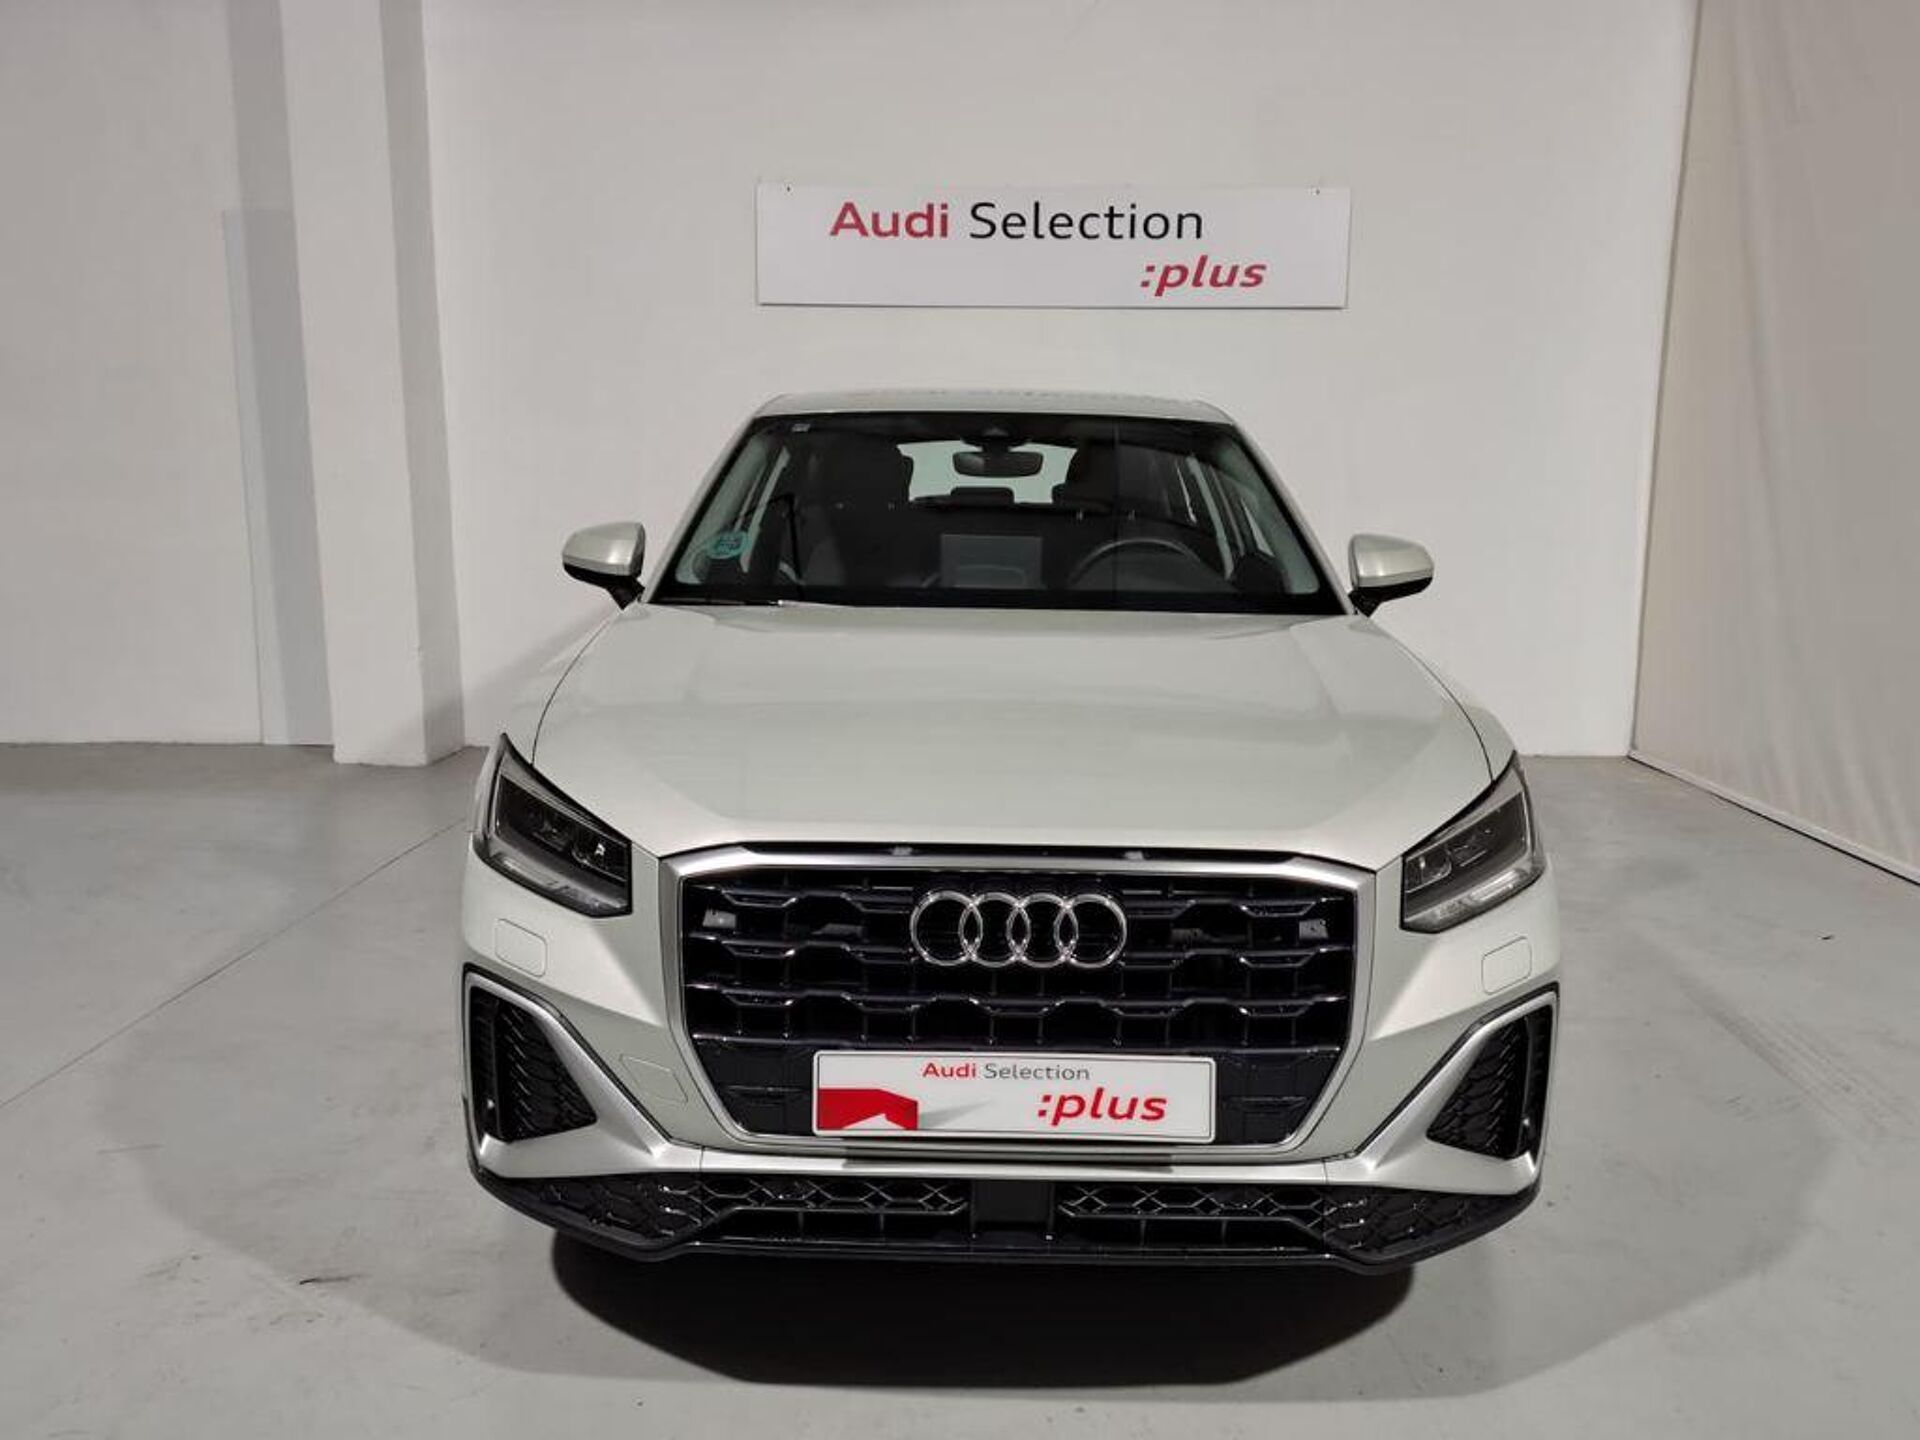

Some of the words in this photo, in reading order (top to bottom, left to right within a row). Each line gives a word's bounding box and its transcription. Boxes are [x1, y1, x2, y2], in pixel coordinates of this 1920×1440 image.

[829, 202, 949, 238] Audi
[968, 201, 1204, 240] Selection
[1139, 255, 1267, 297] :plus
[922, 1062, 977, 1081] Audi
[984, 1063, 1091, 1081] Selection
[1037, 1087, 1168, 1127] :plus
